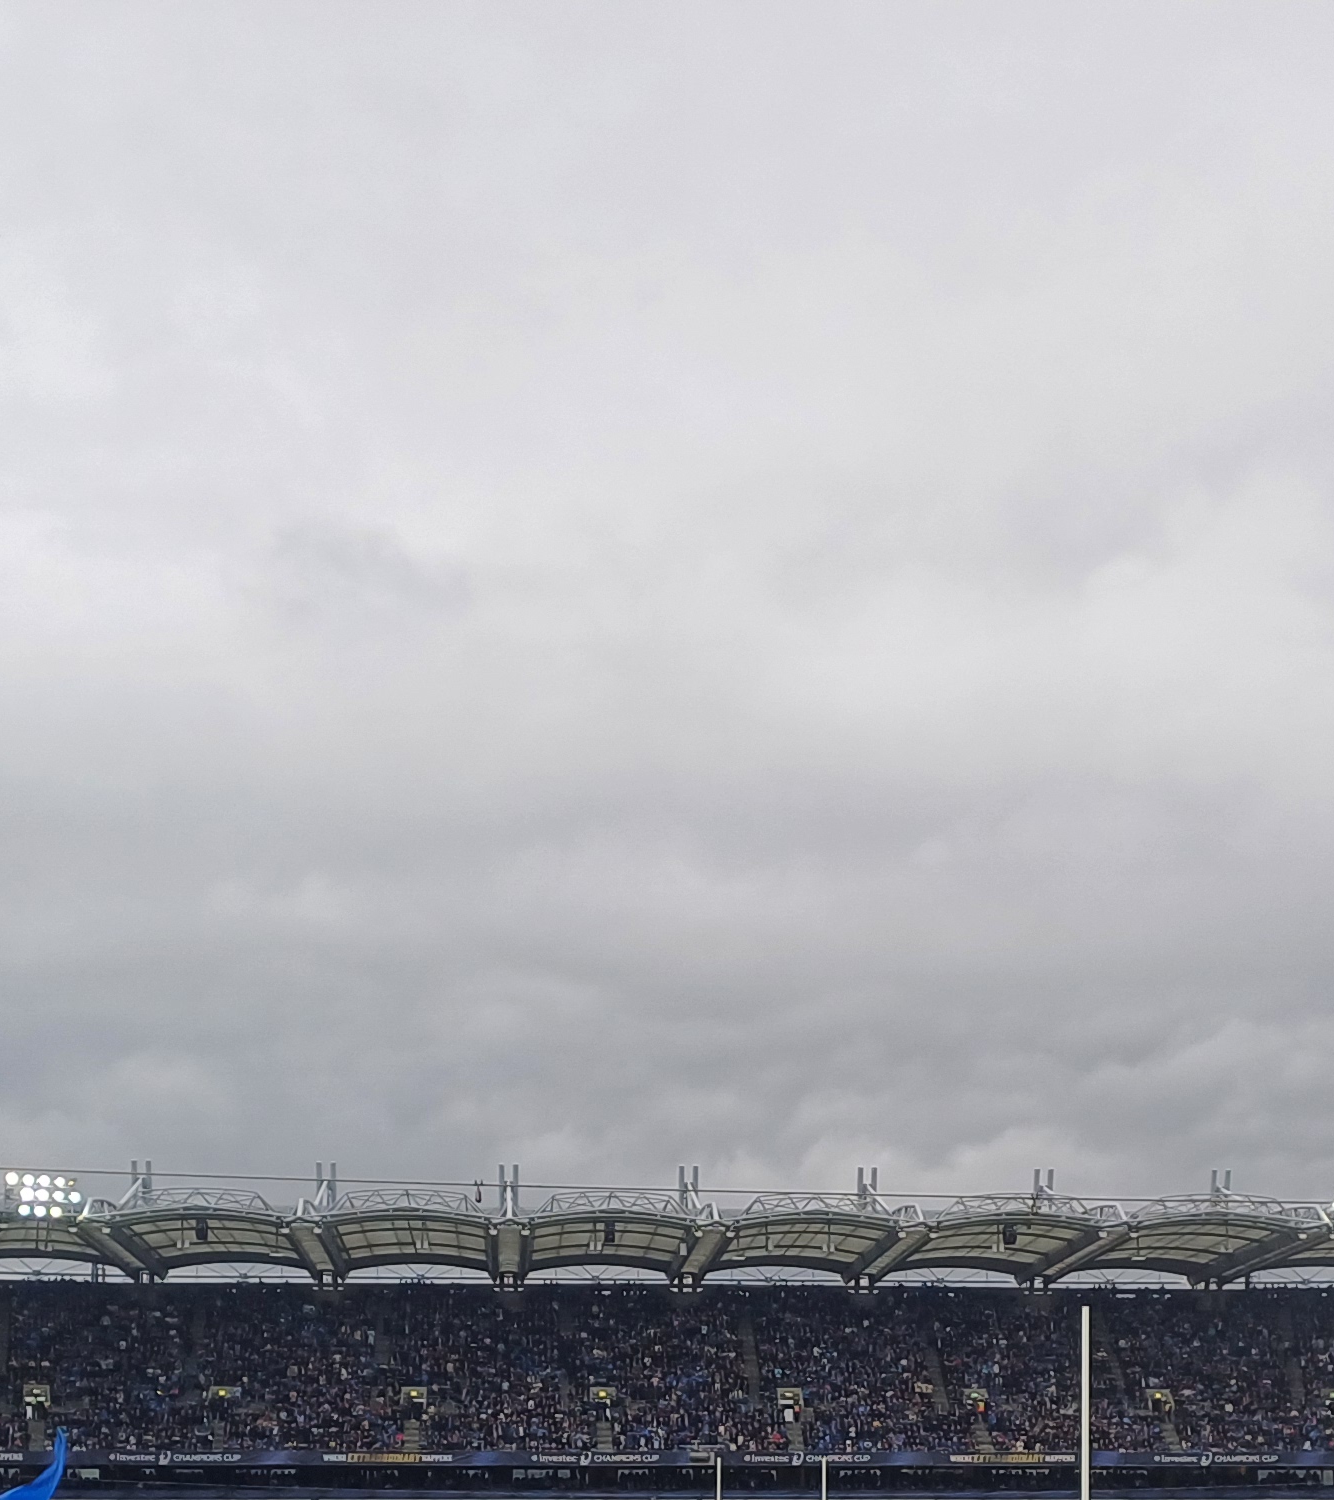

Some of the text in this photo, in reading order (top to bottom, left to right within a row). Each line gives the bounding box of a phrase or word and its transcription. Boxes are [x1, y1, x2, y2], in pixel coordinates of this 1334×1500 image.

[539, 1453, 660, 1463] Investec CHAMPIONS CUP
